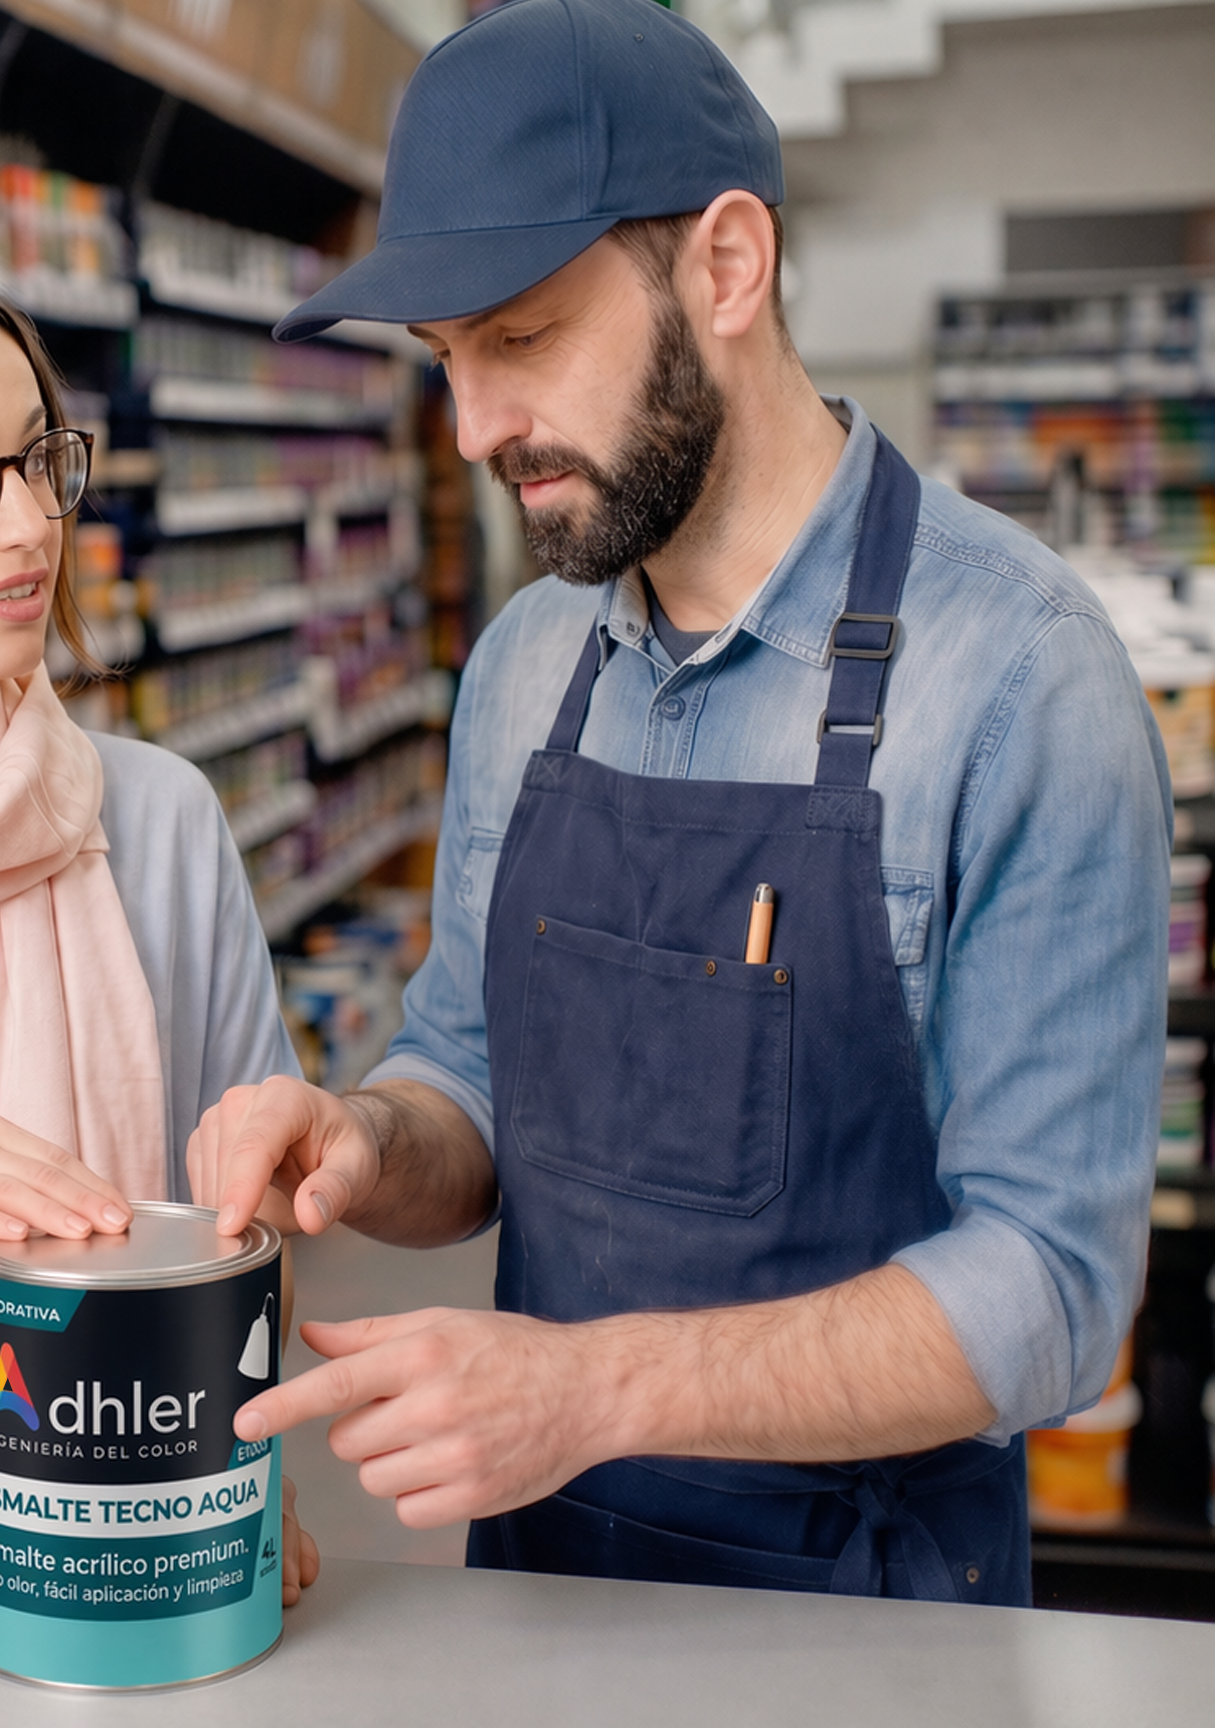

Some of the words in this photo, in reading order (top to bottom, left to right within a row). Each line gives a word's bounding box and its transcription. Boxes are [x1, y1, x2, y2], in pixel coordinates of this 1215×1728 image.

[93, 1446, 130, 1460] DEL
[138, 1439, 198, 1459] COLOR
[98, 1496, 193, 1524] TECNO
[197, 1478, 259, 1516] AQUA
[62, 1552, 148, 1577] acrílico
[155, 1538, 250, 1579] premium.
[7, 1575, 39, 1598] olor,
[44, 1580, 78, 1601] fácil
[82, 1583, 169, 1605] aplicación
[173, 1584, 183, 1602] y
[187, 1569, 244, 1595] limpieza
